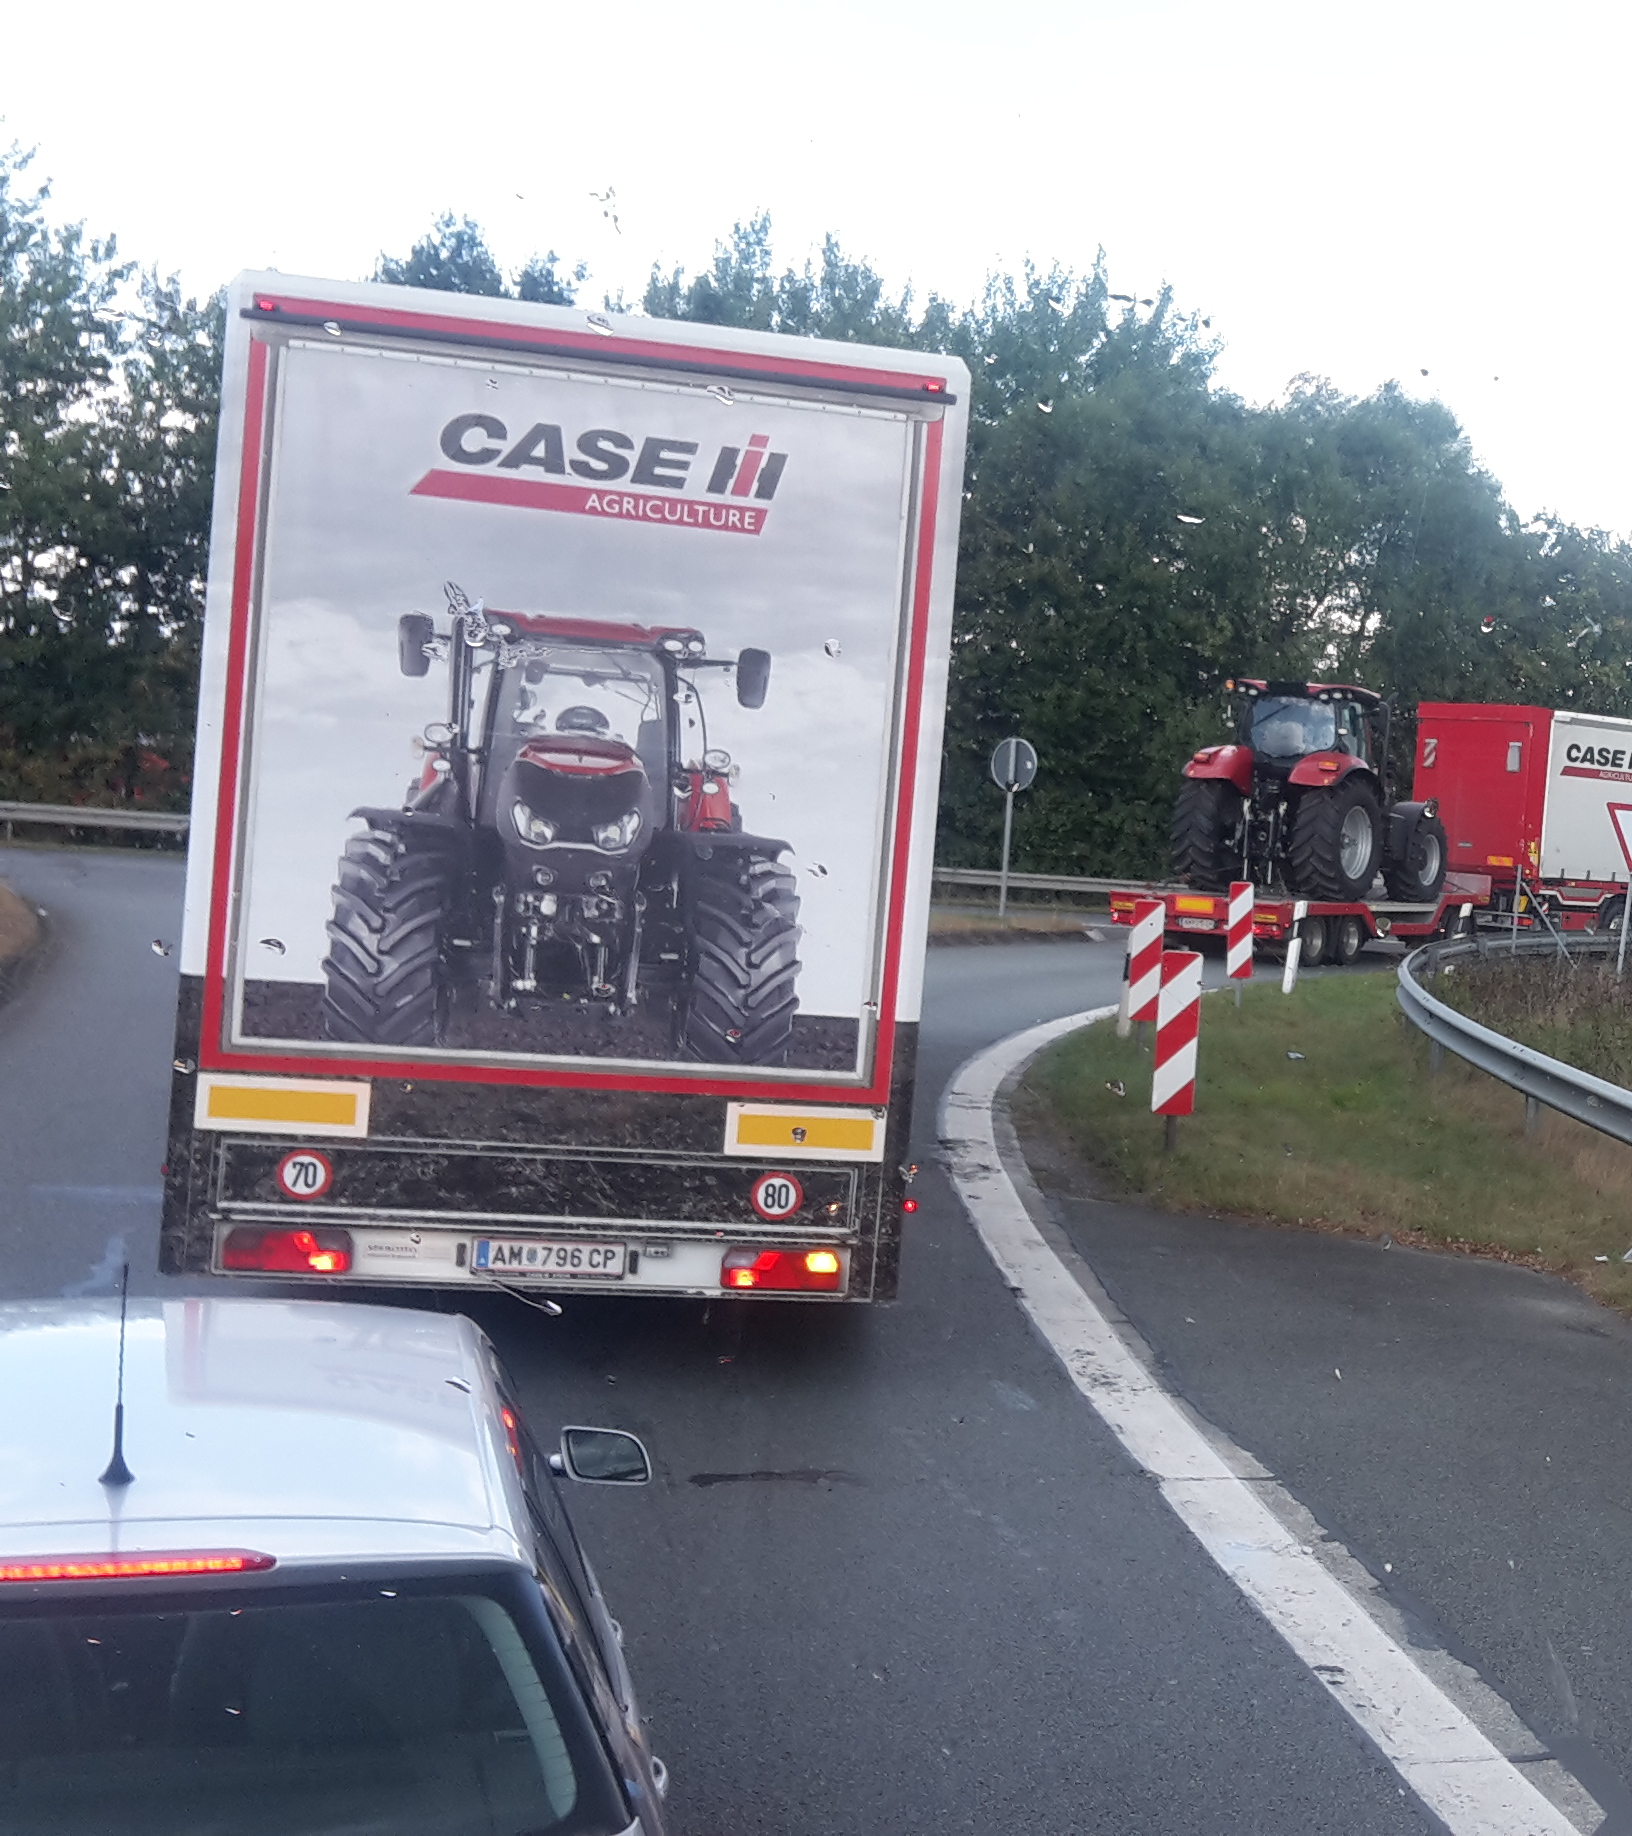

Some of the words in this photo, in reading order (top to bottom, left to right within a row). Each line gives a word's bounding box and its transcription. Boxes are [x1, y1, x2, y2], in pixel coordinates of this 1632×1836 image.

[440, 413, 699, 489] CASE
[585, 494, 756, 530] AGRICULTURE
[1566, 743, 1626, 768] CASE
[291, 1161, 317, 1188] 70
[764, 1183, 789, 1209] 80
[492, 1244, 523, 1266] AM
[540, 1246, 582, 1268] 796
[588, 1249, 616, 1269] CP
